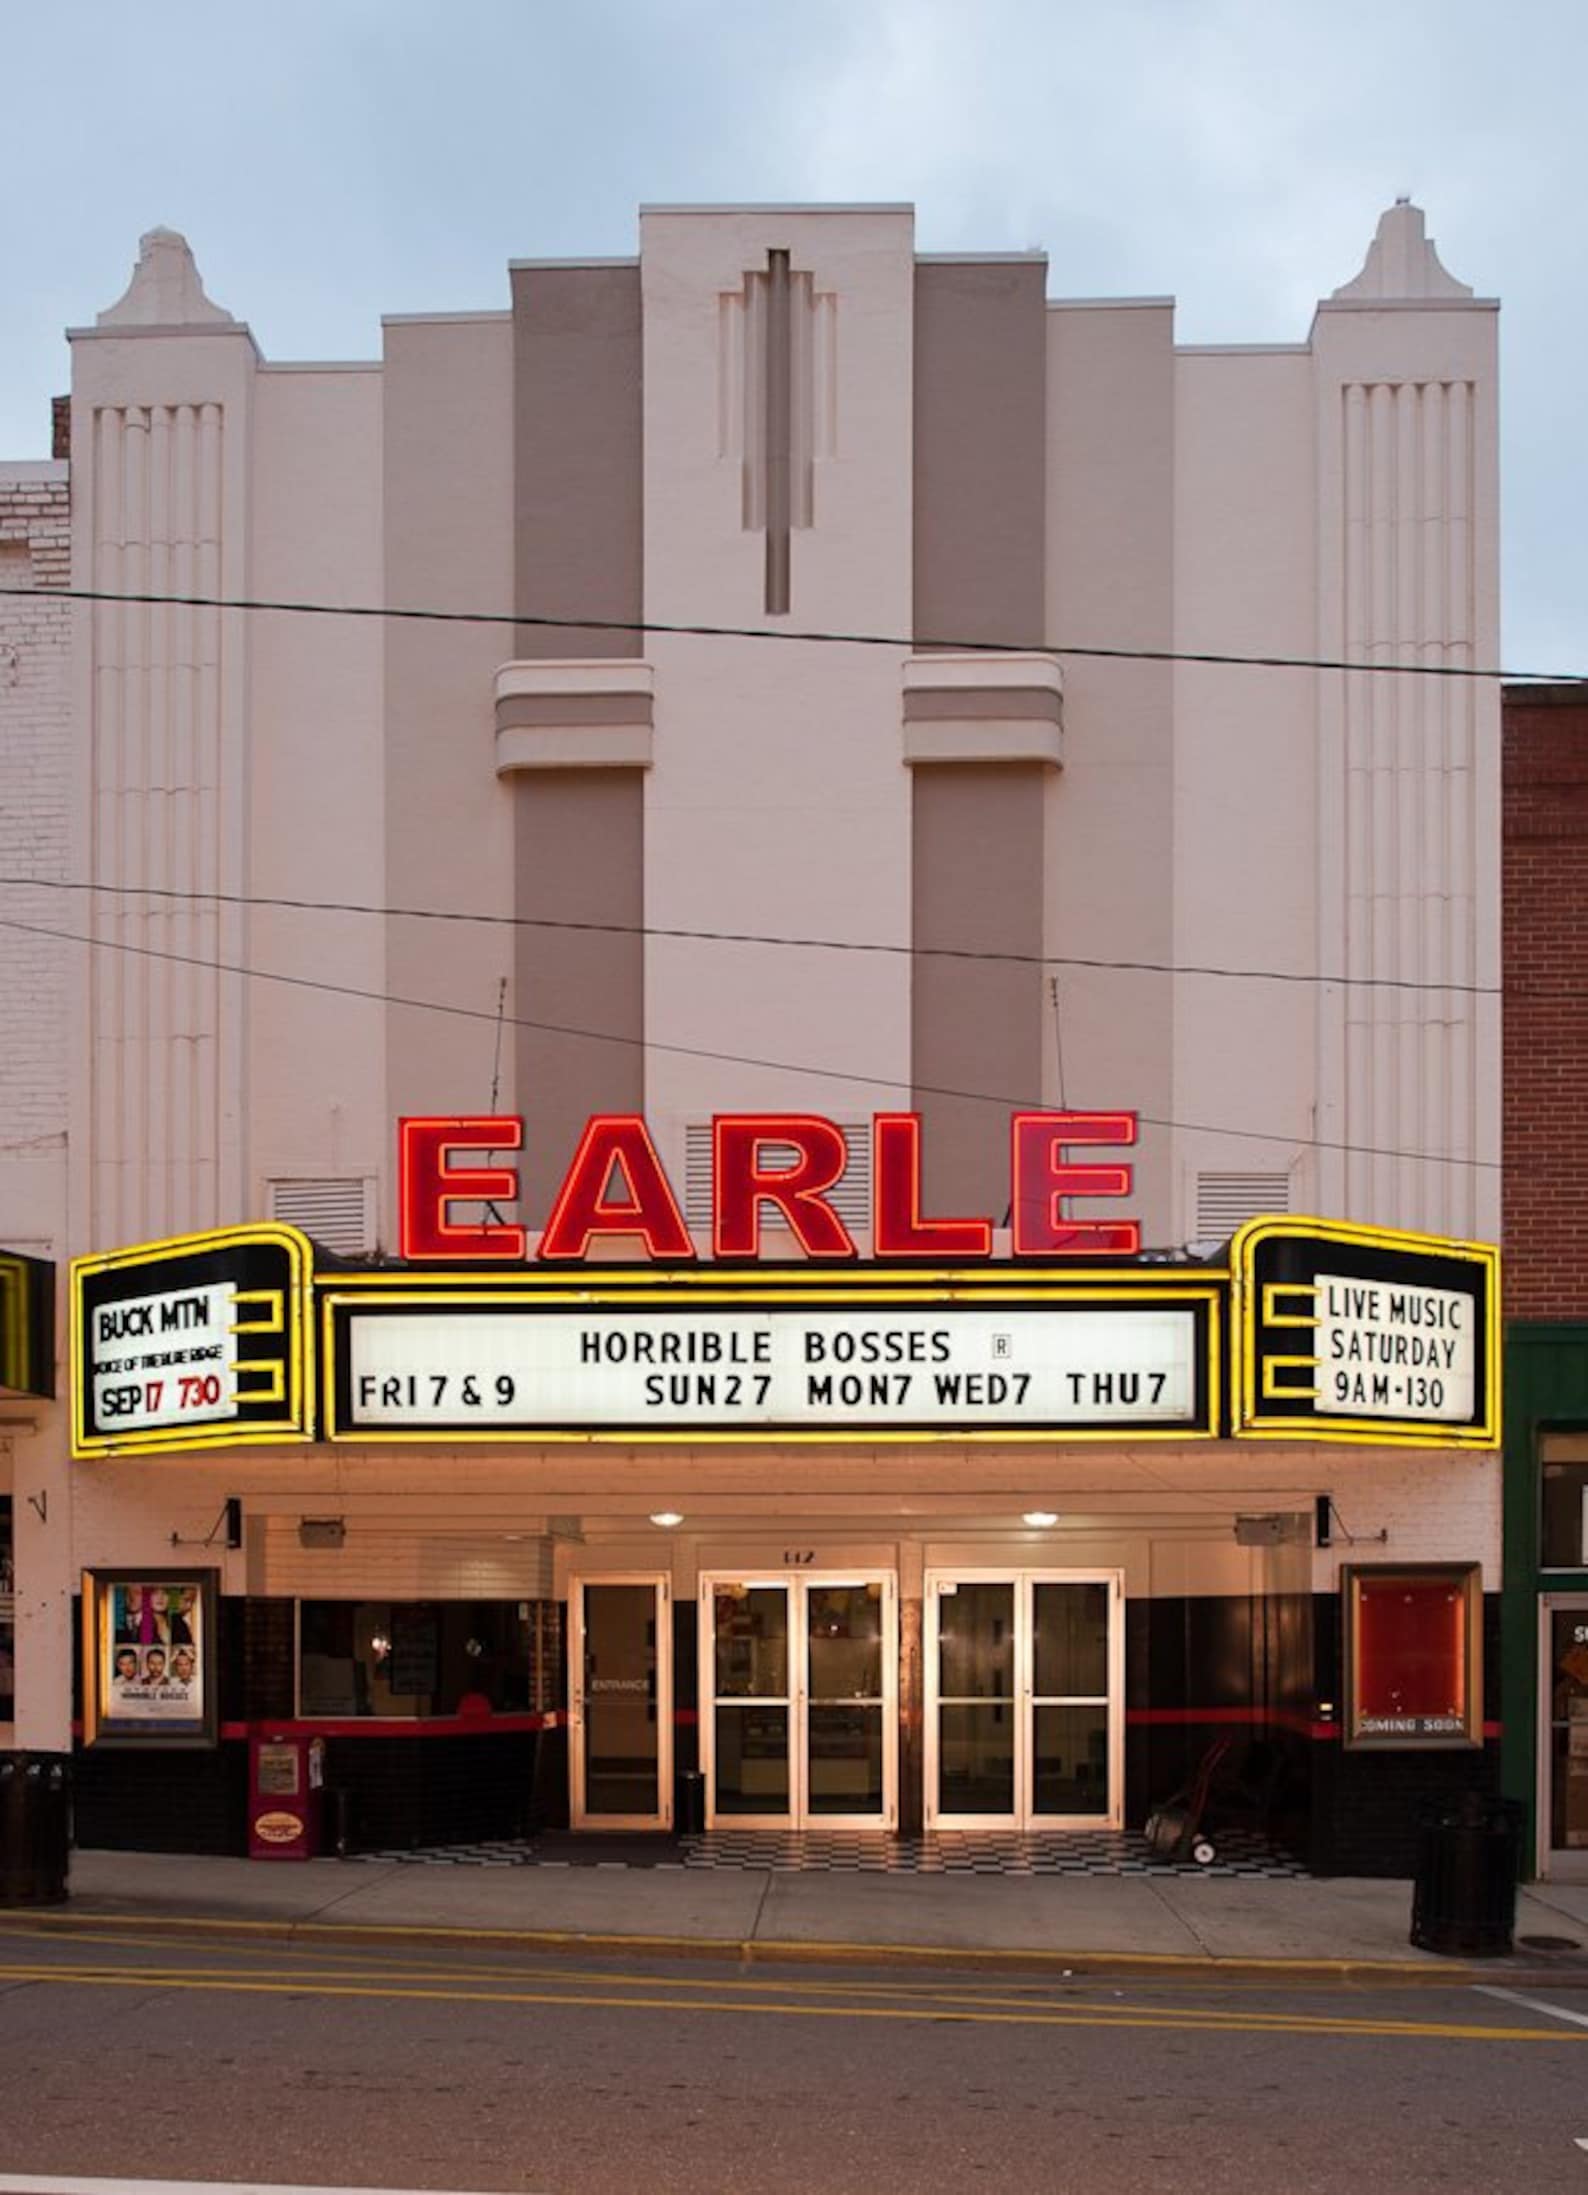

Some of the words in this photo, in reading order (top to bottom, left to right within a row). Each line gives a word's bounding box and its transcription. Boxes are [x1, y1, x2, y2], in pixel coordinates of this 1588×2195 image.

[398, 1111, 1140, 1262] EARLE
[99, 1304, 154, 1342] BUCK
[161, 1295, 209, 1332] MTN
[1329, 1285, 1380, 1321] LIVE
[1390, 1293, 1462, 1330] MUSIC
[580, 1331, 772, 1363] HORRIBLE
[804, 1331, 951, 1363] BOSSES
[1331, 1328, 1456, 1369] SATURDAY
[178, 1375, 221, 1410] 730
[461, 1375, 482, 1406] &
[495, 1375, 516, 1406] 9
[934, 1373, 1032, 1405] WED7
[784, 1550, 814, 1565] 112
